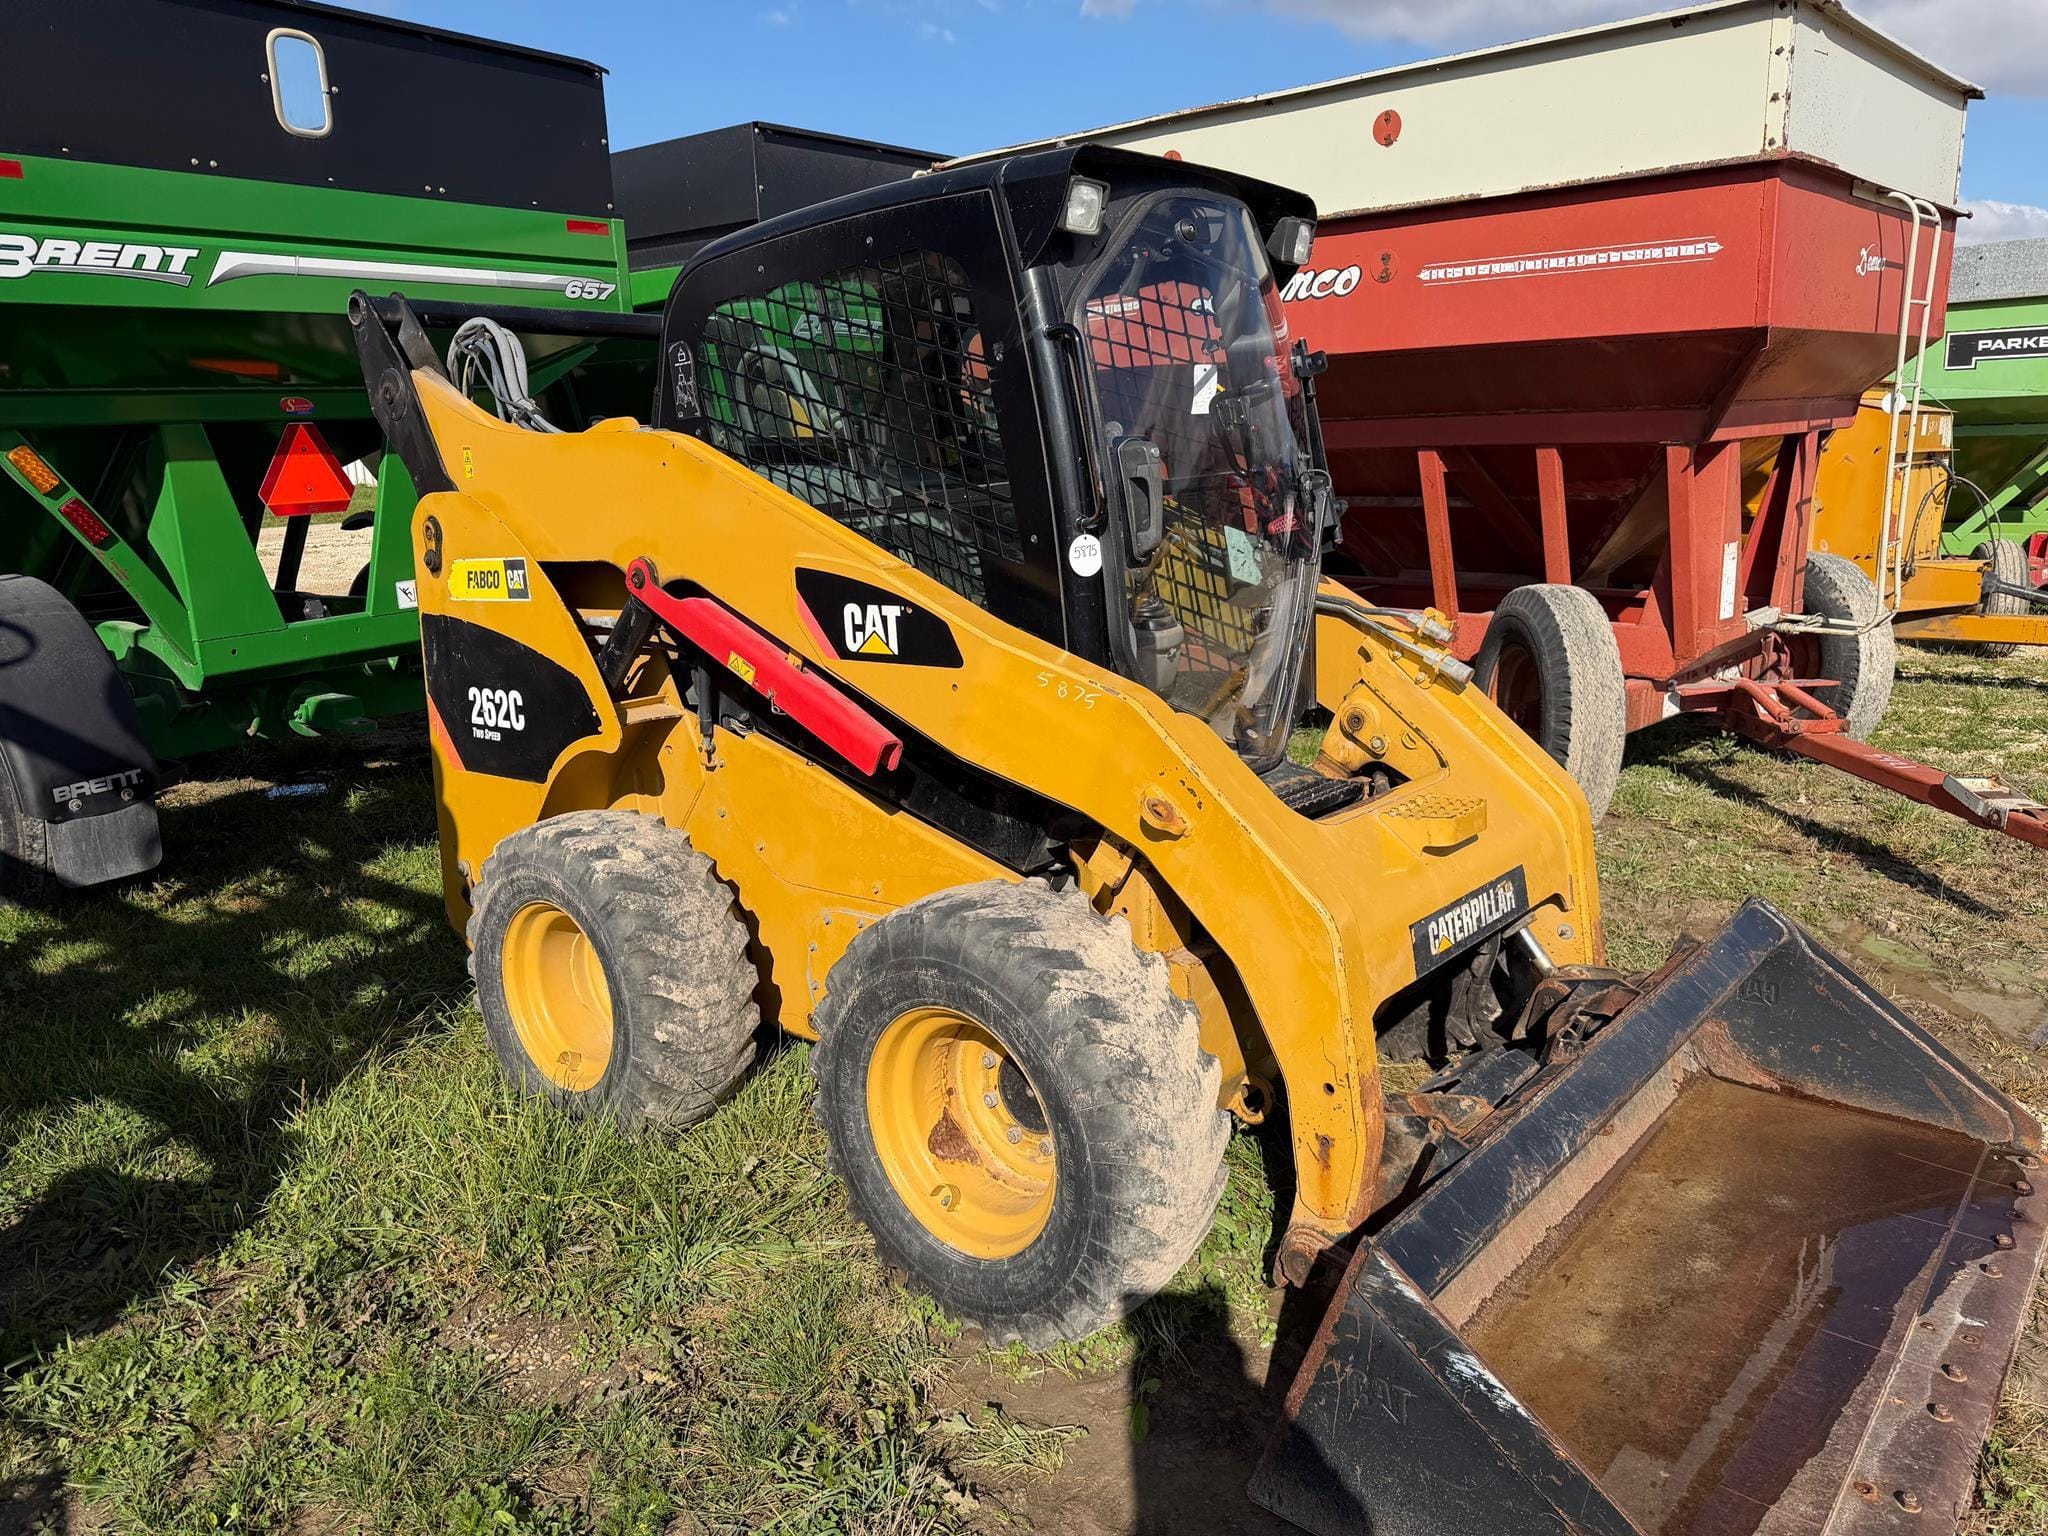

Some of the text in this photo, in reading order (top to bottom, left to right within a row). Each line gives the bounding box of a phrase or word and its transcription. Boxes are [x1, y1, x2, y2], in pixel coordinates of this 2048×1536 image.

[0, 234, 200, 278] BRENT
[565, 280, 617, 301] 657
[1279, 264, 1362, 302] mco
[467, 569, 525, 590] FABCO CAT
[843, 603, 901, 655] CAT
[468, 686, 525, 731] 262C
[1036, 672, 1102, 709] 5875
[1428, 880, 1516, 955] CATERPILLAR
